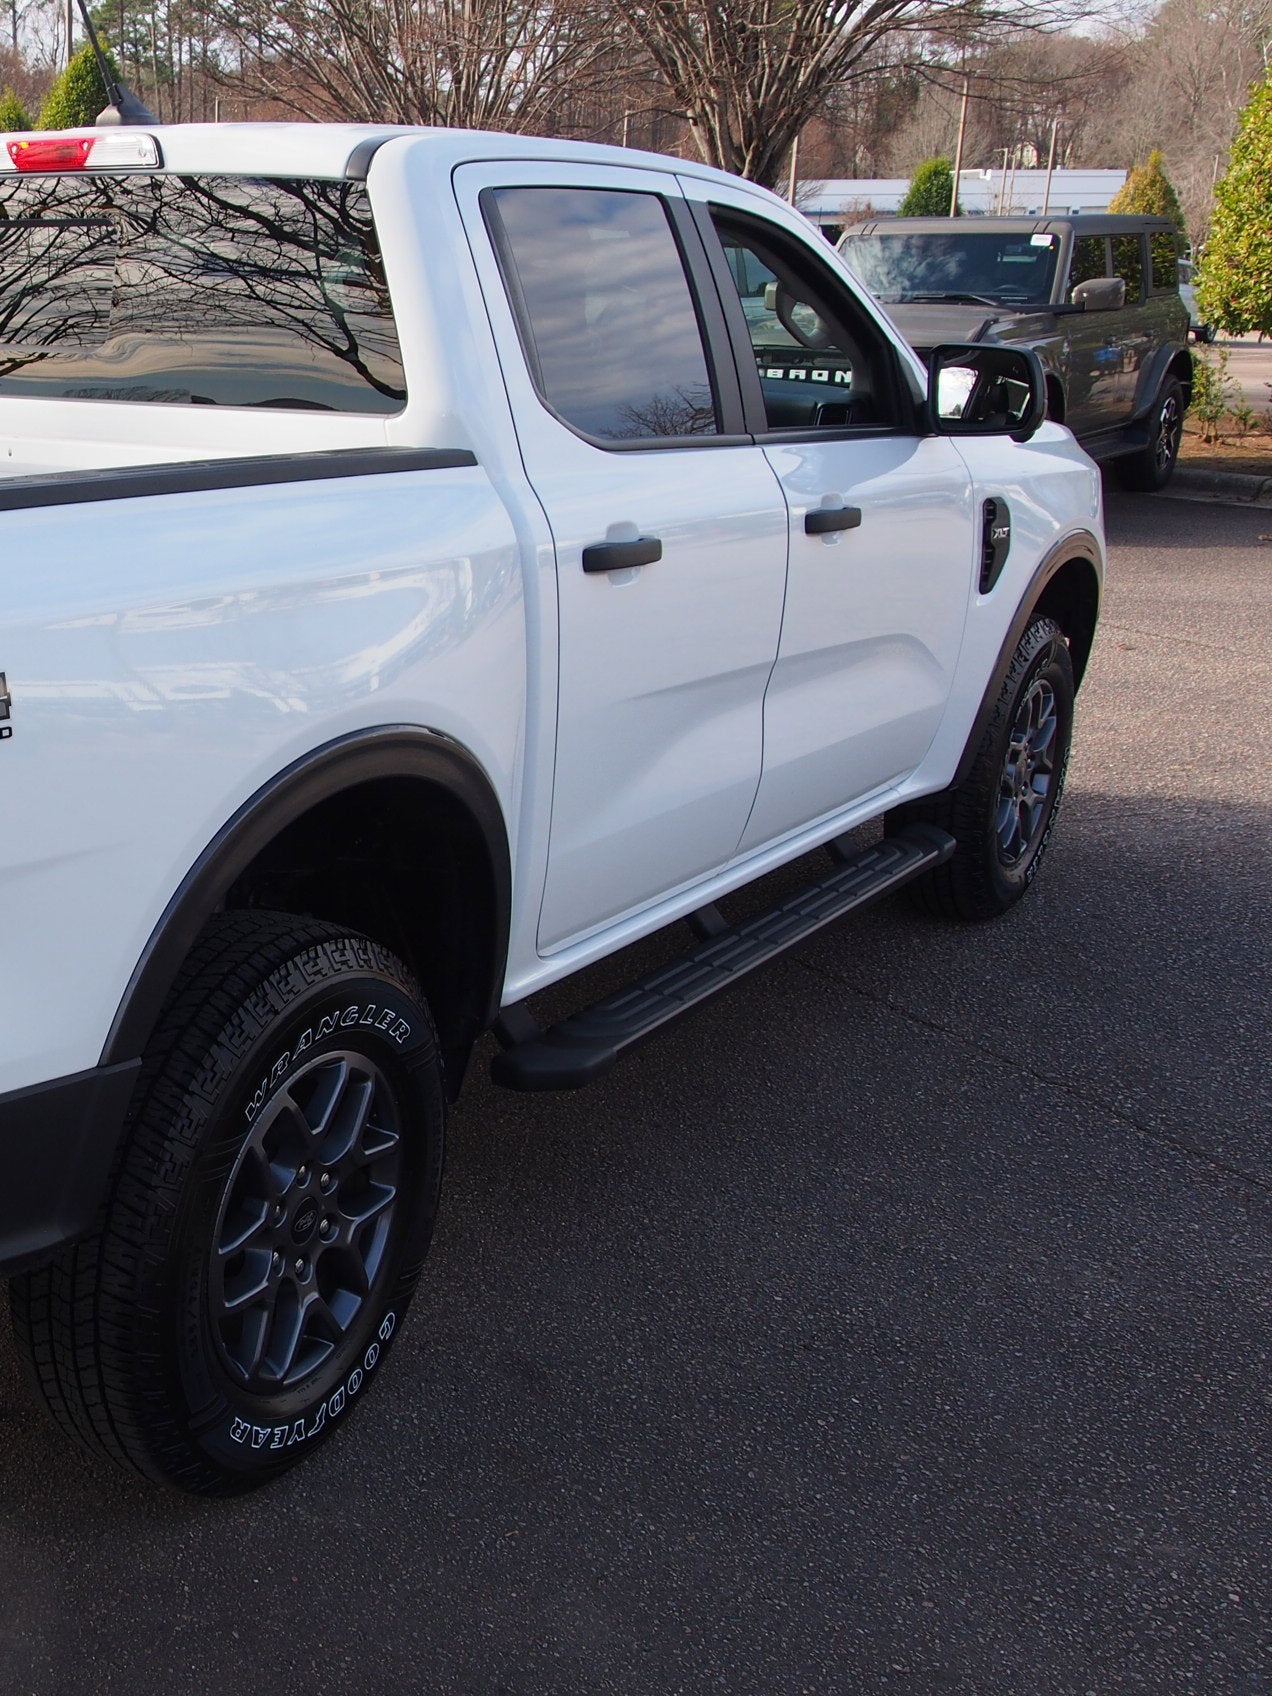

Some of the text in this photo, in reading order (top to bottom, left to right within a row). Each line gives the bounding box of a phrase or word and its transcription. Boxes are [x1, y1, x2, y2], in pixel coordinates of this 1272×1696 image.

[766, 368, 852, 383] BRON
[992, 527, 1010, 539] XLT
[243, 1003, 413, 1122] WRANGLER
[230, 1311, 396, 1450] GOODYEAR
